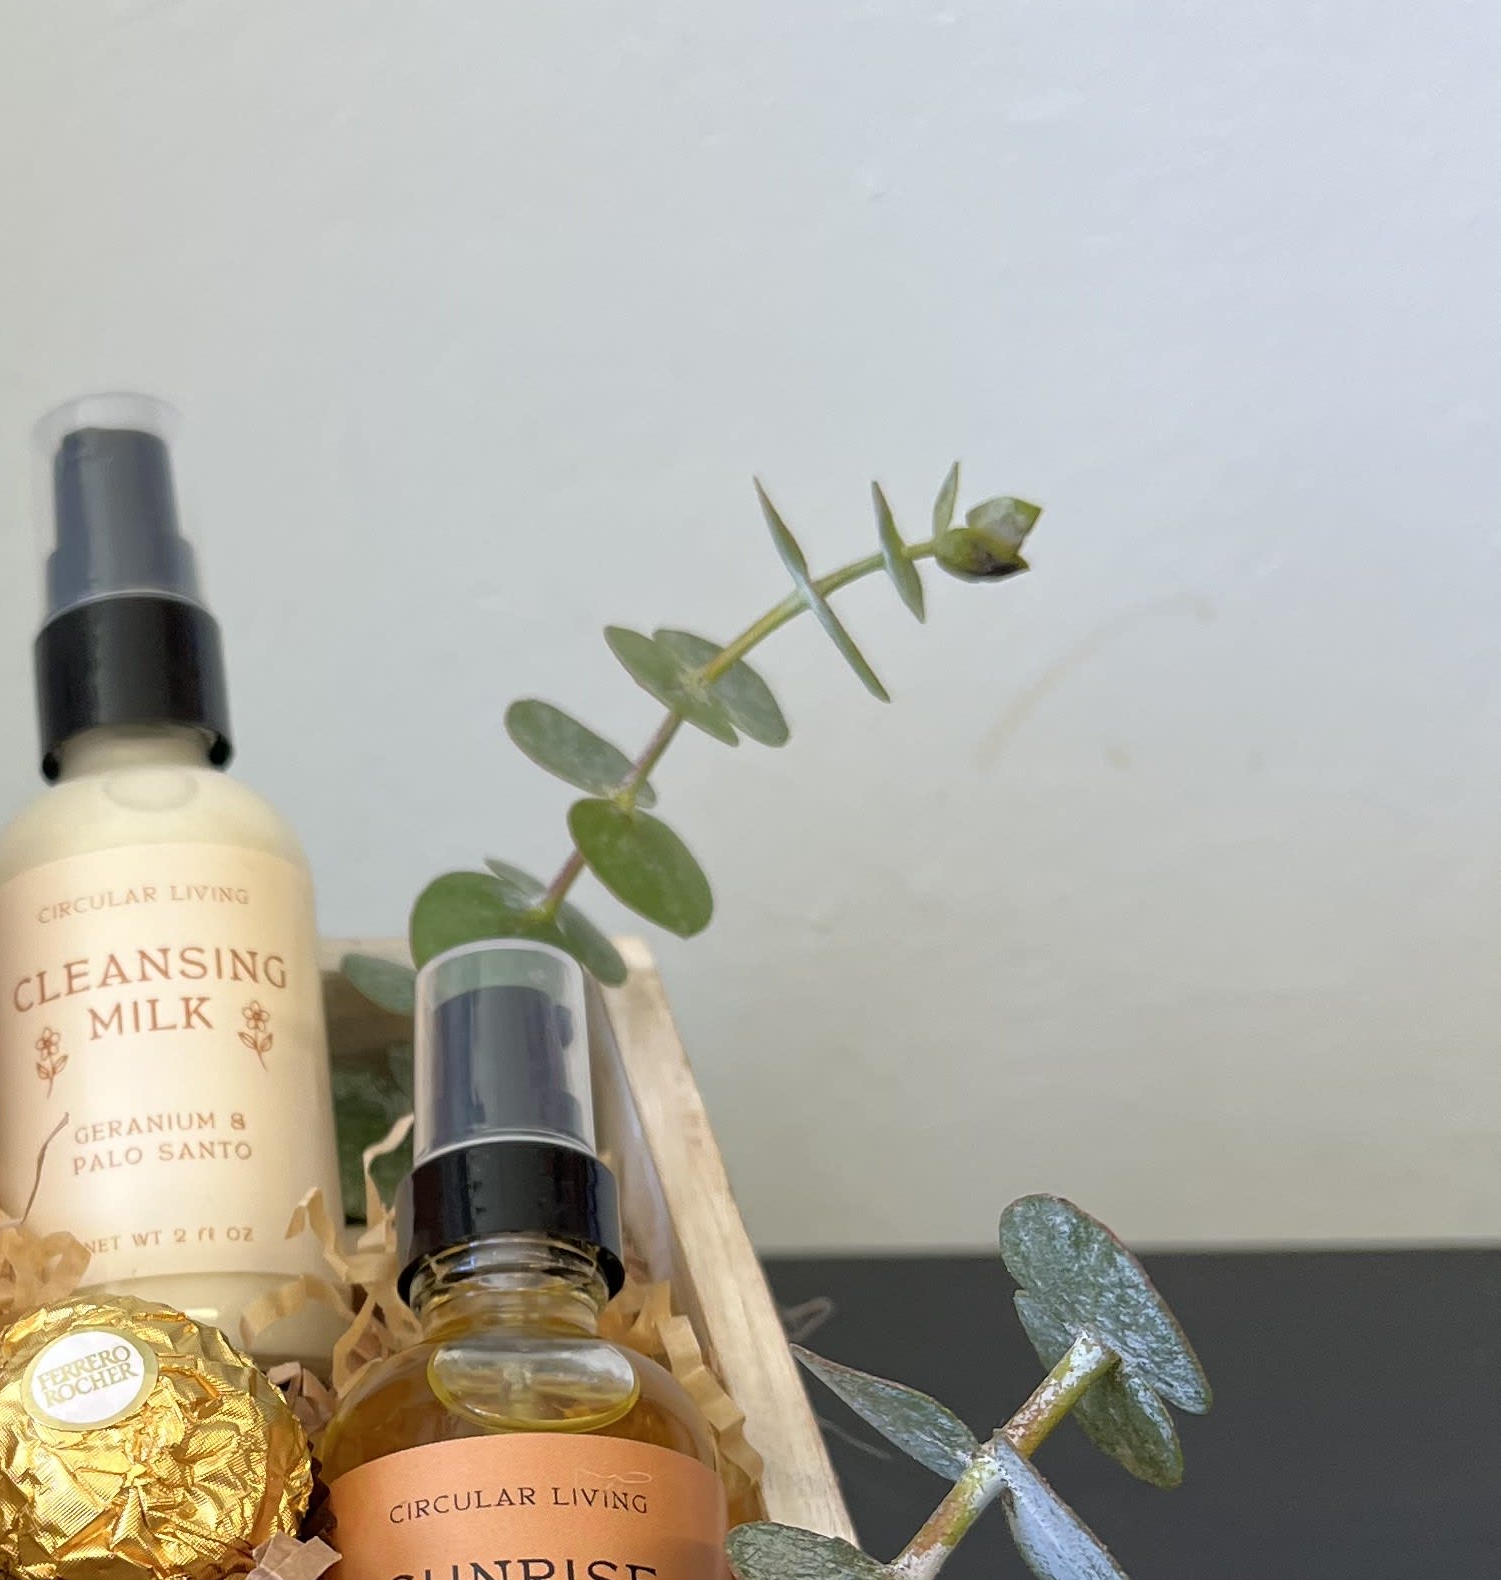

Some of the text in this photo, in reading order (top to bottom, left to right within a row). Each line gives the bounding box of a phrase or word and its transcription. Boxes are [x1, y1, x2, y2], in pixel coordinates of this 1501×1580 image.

[37, 884, 251, 924] CIRCULAR LIVING
[13, 946, 288, 1012] CLEANSING
[87, 996, 214, 1040] MILK
[74, 1112, 246, 1145] GERANIUM &
[73, 1140, 253, 1175] PALO SANTO
[85, 1235, 121, 1254] NET
[131, 1230, 162, 1247] WT
[173, 1228, 186, 1243] 2
[226, 1227, 255, 1242] OZ
[37, 1345, 131, 1391] FERRERO
[43, 1362, 138, 1409] ROCHER
[389, 1486, 647, 1524] CIRCULAR LIVING
